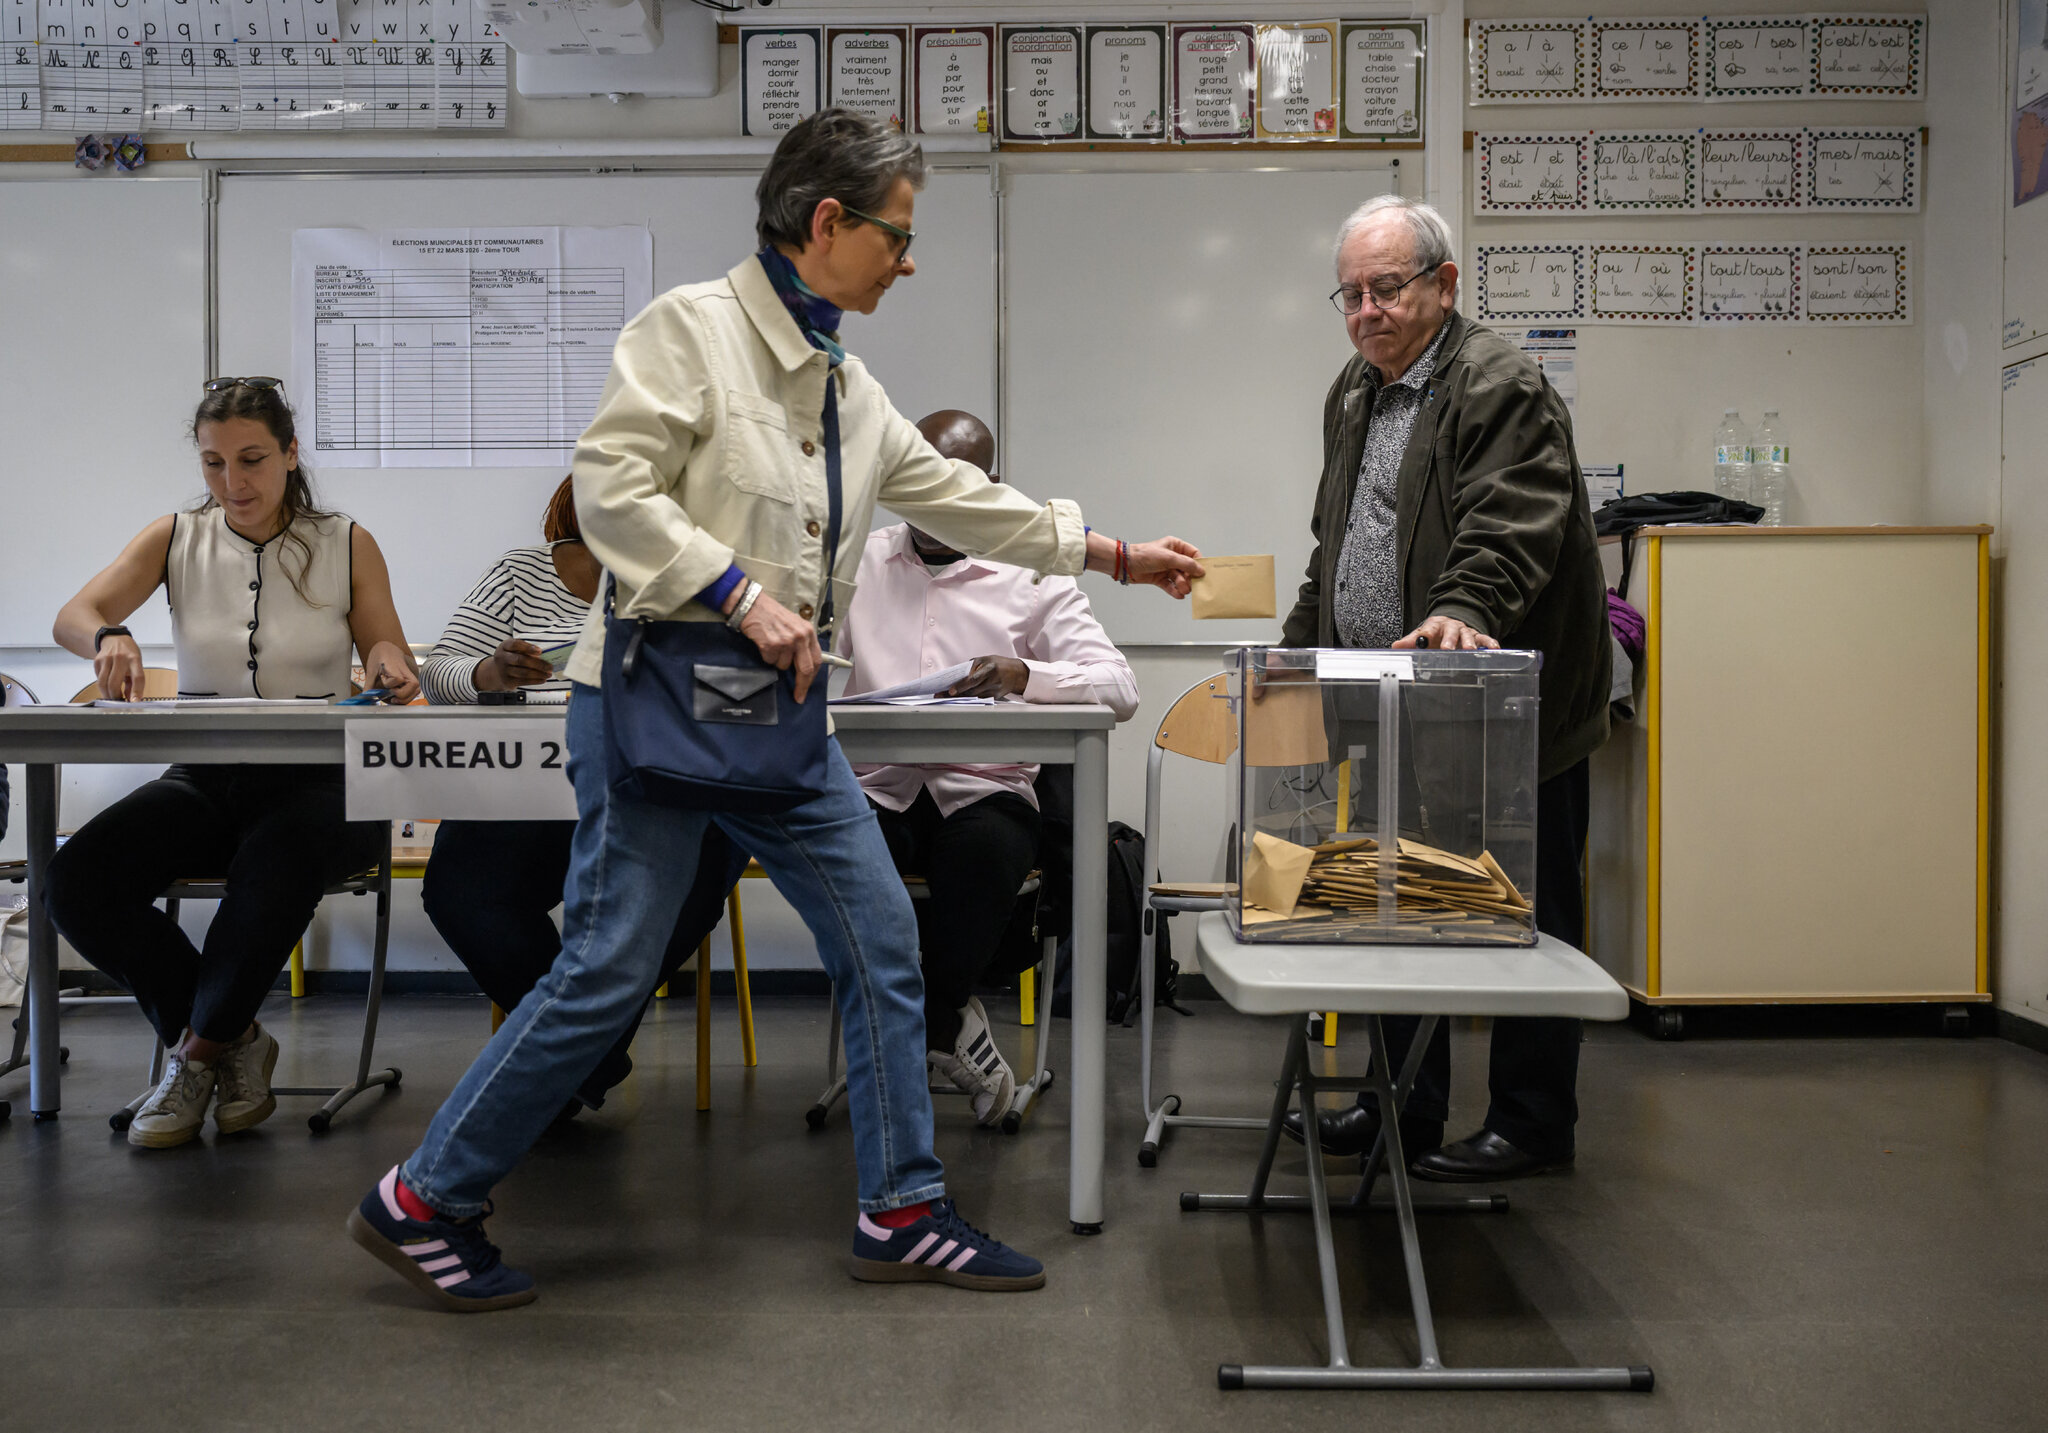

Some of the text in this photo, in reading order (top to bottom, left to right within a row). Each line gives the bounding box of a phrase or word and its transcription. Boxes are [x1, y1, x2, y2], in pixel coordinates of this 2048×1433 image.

[18, 16, 493, 42] l m n o p q r s t u v w x y z
[1011, 33, 1073, 43] conjonctions
[1104, 36, 1147, 46] pronoms
[1368, 32, 1394, 40] noms
[765, 39, 797, 48] verbes
[844, 38, 889, 48] adverbes
[926, 36, 983, 47] prépositions
[1357, 41, 1406, 49] communs
[1504, 39, 1555, 52] a à
[1611, 39, 1674, 50] ce se
[1718, 37, 1797, 50] ces ses
[1011, 43, 1073, 52] coordination
[845, 55, 888, 65] vraiment
[950, 52, 957, 62] à
[1031, 56, 1053, 65] mais
[1119, 52, 1129, 63] je
[1198, 56, 1228, 66] rouge
[1368, 53, 1394, 62] table
[762, 58, 800, 68] manger
[946, 63, 960, 72] de
[767, 68, 799, 78] dormir
[841, 66, 892, 77] beaucoup
[1035, 67, 1048, 75] ou
[1120, 64, 1130, 73] tu
[1202, 66, 1225, 76] petit
[1364, 64, 1397, 73] chaise
[767, 79, 795, 88] courir
[857, 76, 875, 86] très
[945, 74, 963, 83] par
[1037, 77, 1047, 86] et
[1122, 75, 1127, 85] il
[1199, 77, 1228, 87] grand
[1361, 74, 1400, 84] docteur
[762, 89, 800, 99] réfléchir
[841, 87, 890, 97] lentement
[942, 85, 965, 94] pour
[1029, 88, 1055, 97] donc
[1118, 88, 1131, 96] on
[1194, 87, 1233, 96] heureux
[1364, 86, 1399, 96] crayon
[941, 95, 966, 104] avec
[1037, 99, 1048, 107] or
[1113, 100, 1136, 108] nous
[1196, 97, 1232, 106] bavard
[1283, 97, 1310, 105] cette
[1363, 96, 1397, 105] voiture
[762, 100, 800, 110] prendre
[947, 106, 961, 115] sur
[1038, 109, 1047, 118] ni
[1119, 111, 1130, 120] lui
[1196, 108, 1230, 118] longue
[1366, 107, 1394, 118] girafe
[768, 112, 795, 120] poser
[772, 121, 791, 130] dire
[947, 118, 960, 126] en
[1034, 120, 1051, 128] car
[1197, 118, 1230, 128] sévère
[1363, 117, 1396, 127] enfant
[1500, 150, 1565, 165] est et
[1531, 190, 1545, 201] et
[1493, 259, 1567, 275] ont on
[1602, 262, 1671, 275] ou où
[362, 741, 568, 769] BUREAU 2
